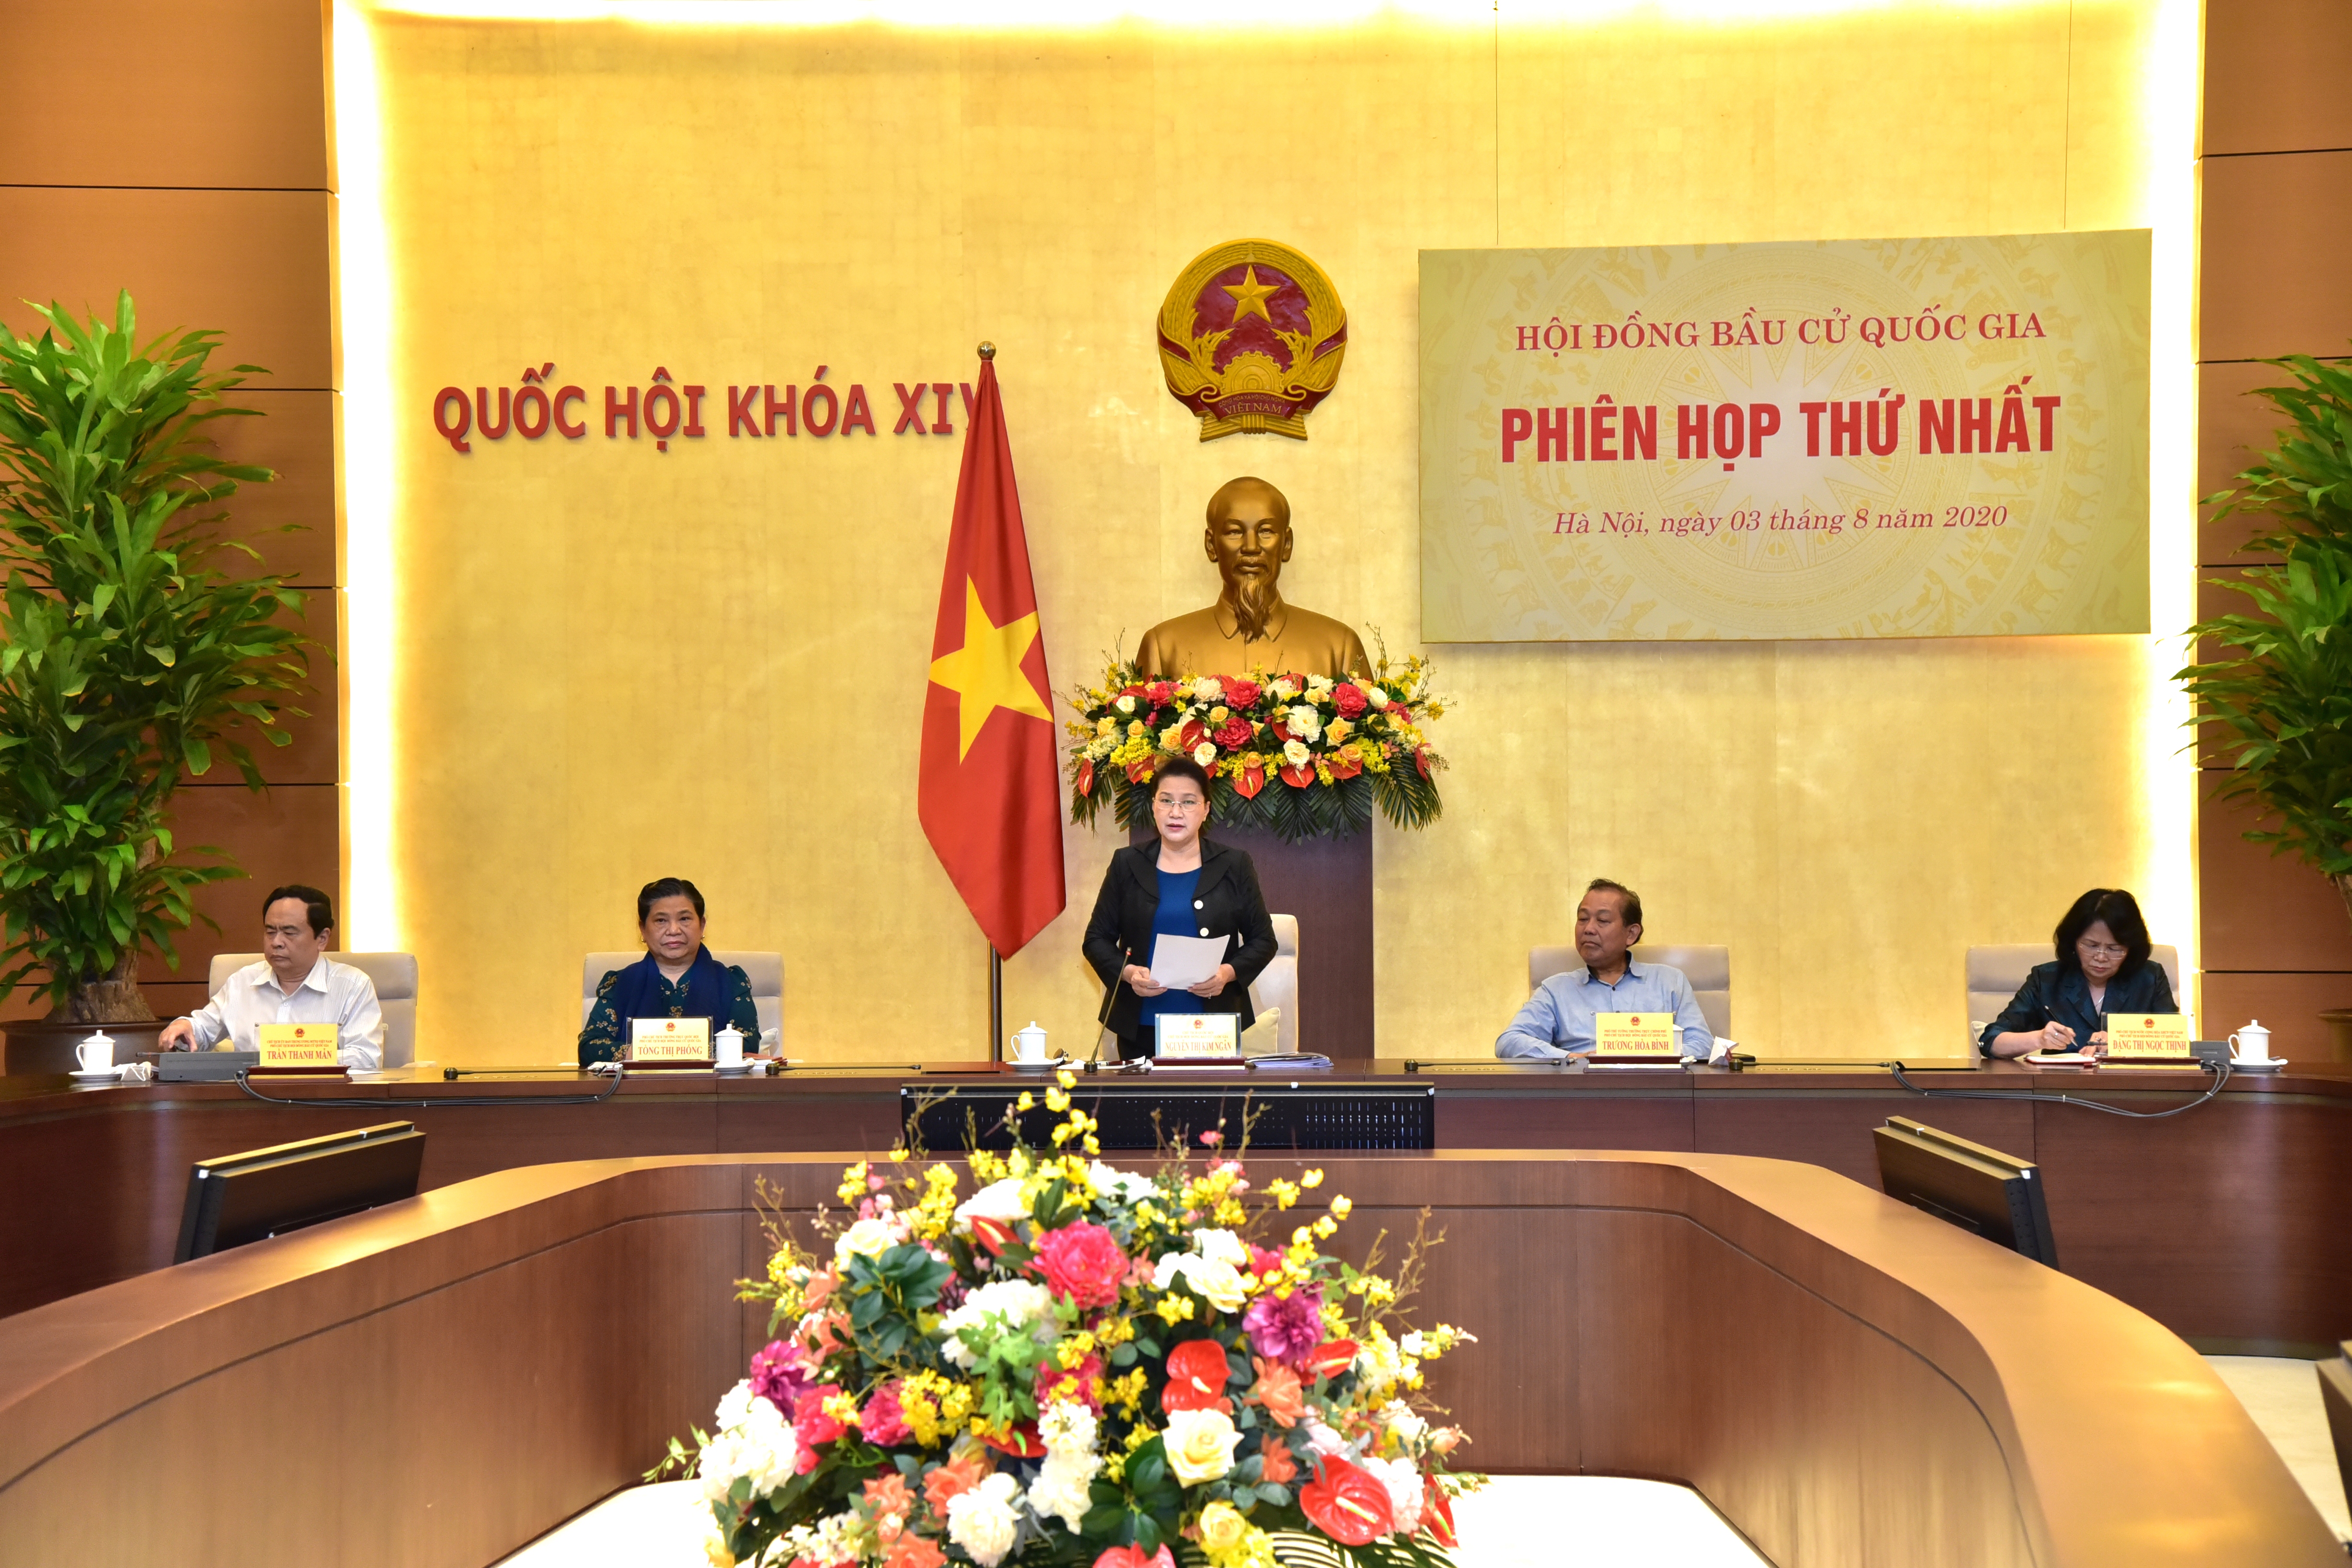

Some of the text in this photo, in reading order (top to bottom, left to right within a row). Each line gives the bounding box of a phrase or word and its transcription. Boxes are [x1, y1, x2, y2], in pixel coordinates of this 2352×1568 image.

[1516, 303, 2047, 358] HỘI ĐỒNG BẦU CỬ QUỐC GIA
[433, 362, 585, 452] QUỐC
[605, 366, 704, 450] HỘI
[728, 365, 876, 436] KHÓA
[1224, 402, 1282, 414] VIỆT NAM
[1501, 374, 2062, 472] PHIÊN HỌP THỨ NHẤT
[1552, 506, 2008, 538] Hà Nội, ngày 03 tháng 8 năm 2020
[638, 1044, 702, 1057] TÒNG THỊ PHÓNG
[1191, 1042, 1200, 1053] THỊ
[1202, 1042, 1214, 1051] KIM
[1215, 1039, 1231, 1051] NGÂN
[1602, 1038, 1669, 1050] TRƯƠNG HÒA BÌNH
[2113, 1038, 2186, 1052] ĐẶNG THỊ NGỌC THỊNH
[267, 1048, 287, 1059] TRẦN
[288, 1051, 314, 1059] THANH
